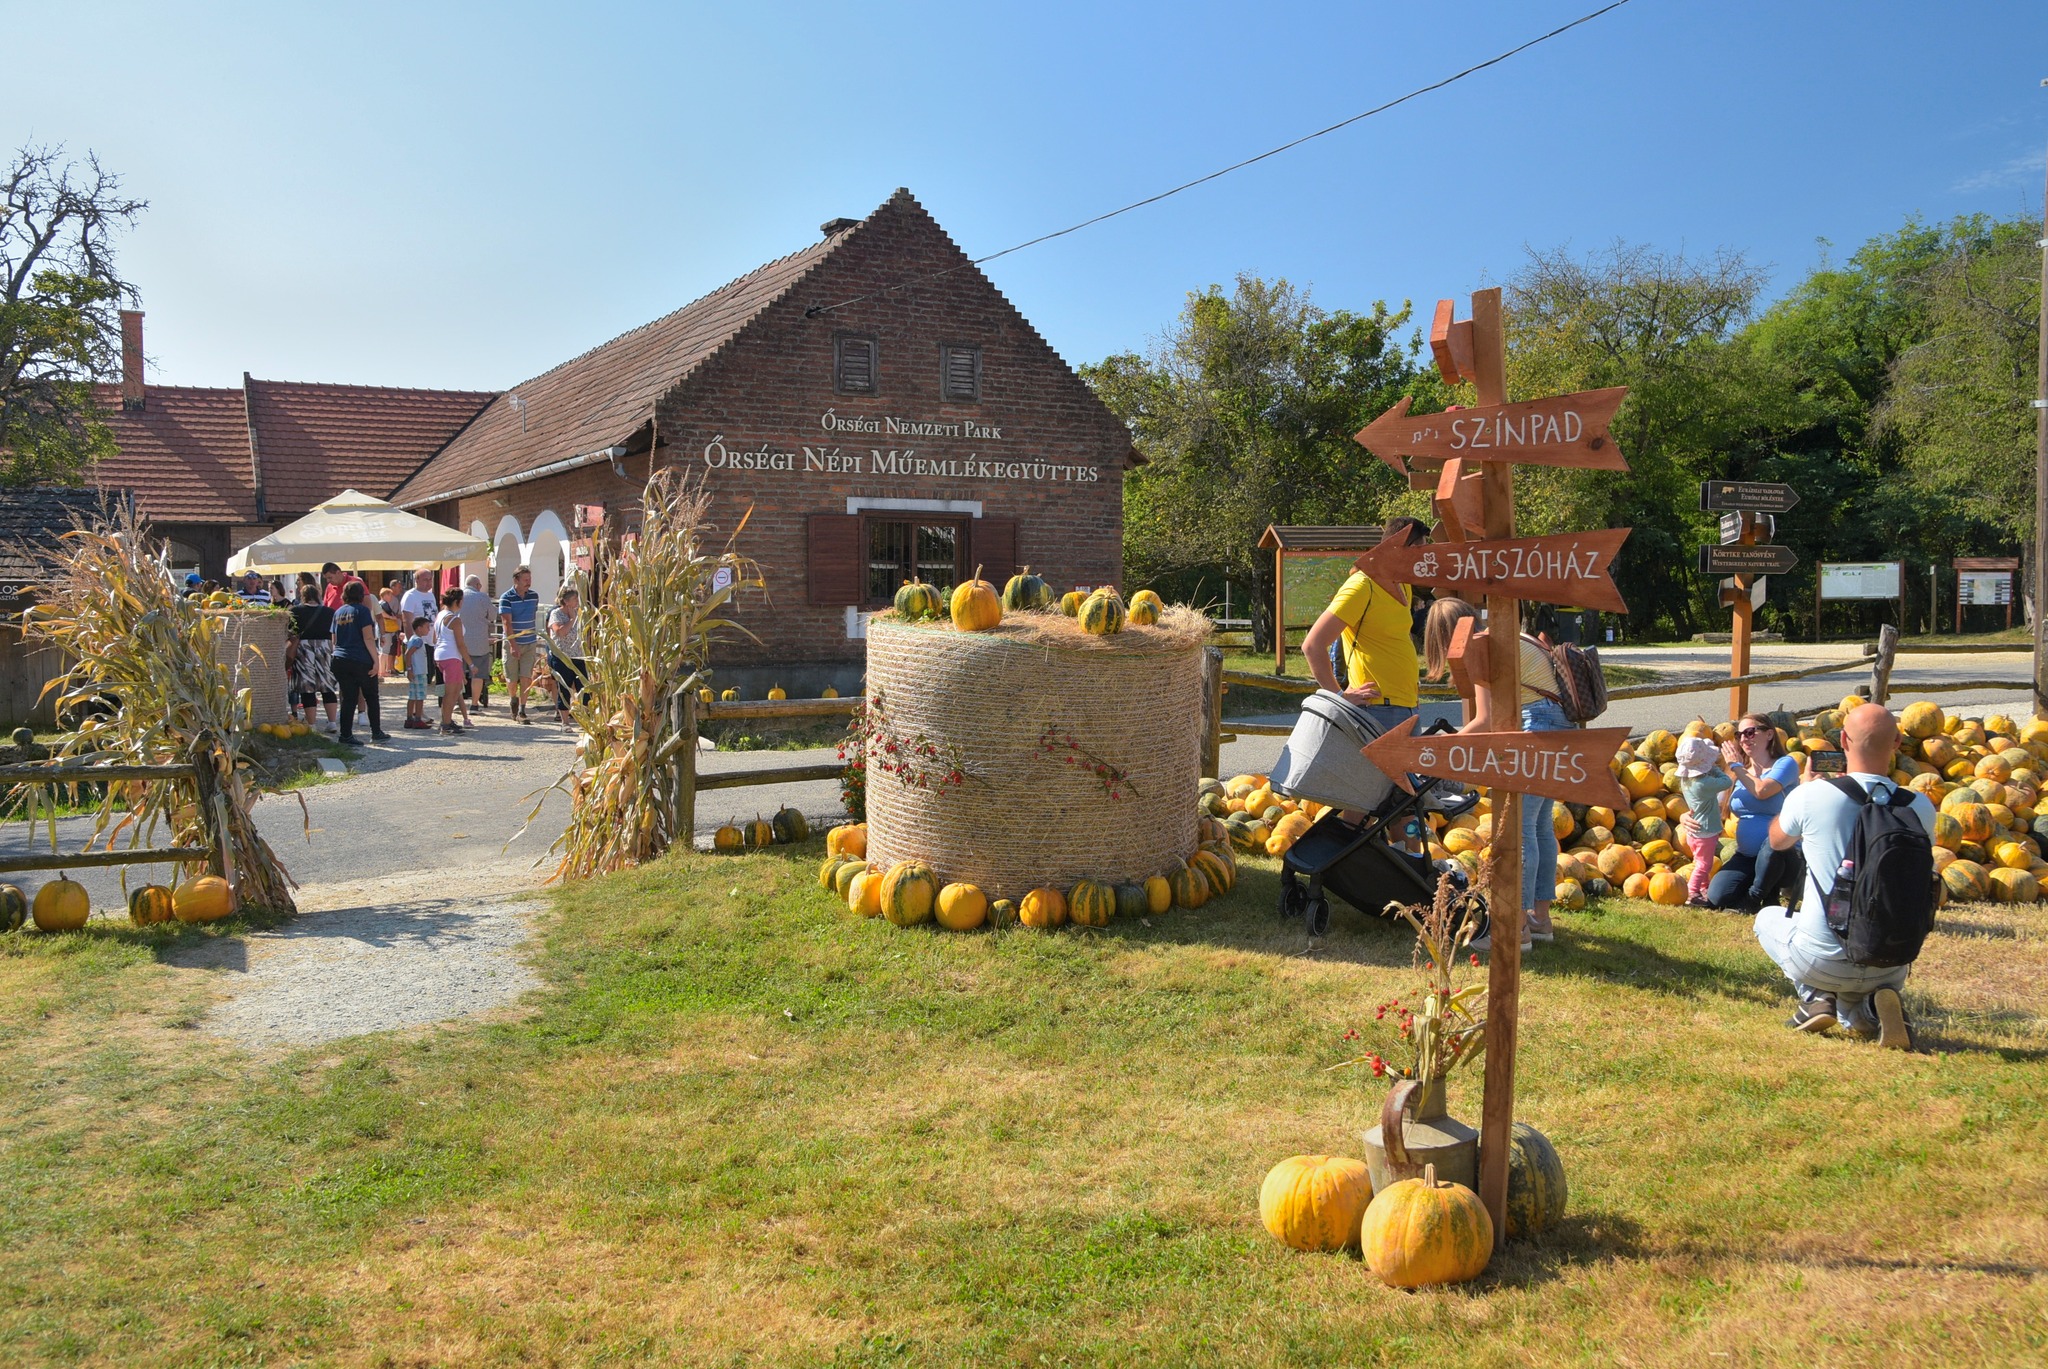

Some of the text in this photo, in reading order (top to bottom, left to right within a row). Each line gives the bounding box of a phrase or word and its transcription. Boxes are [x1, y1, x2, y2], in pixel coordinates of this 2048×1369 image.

[821, 408, 1001, 439] ŐRSÉGI NEMZETI PARK
[1450, 411, 1582, 449] SZÍNPAD
[704, 434, 1098, 482] ŐRSÉGI NÉPI MŰEMLÉKEGYÜTTES
[1446, 542, 1601, 581] JÁTSZÓHÁZ
[0, 585, 19, 595] OS
[1449, 745, 1587, 783] OLAJÜTÉS
